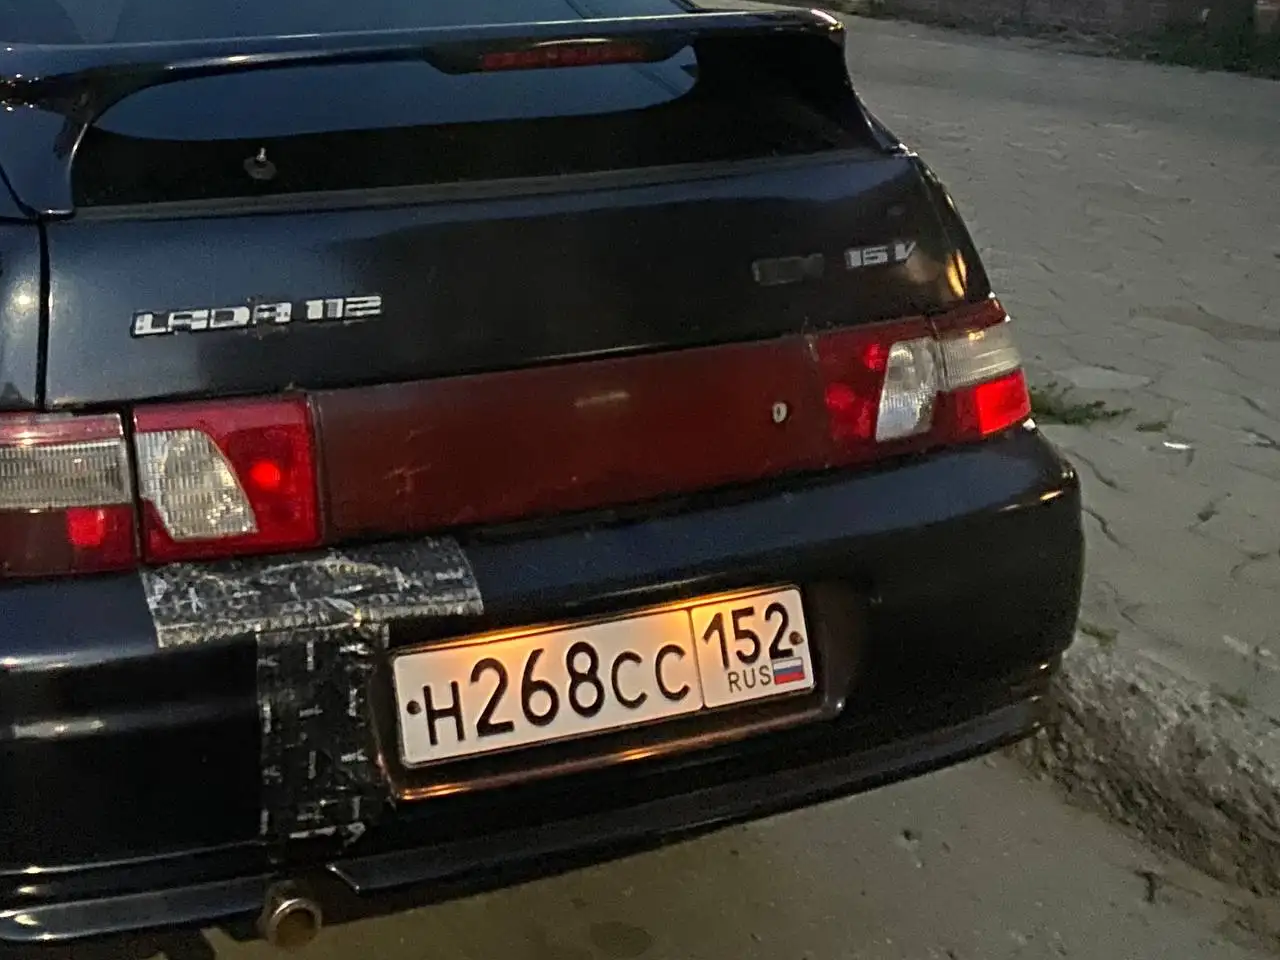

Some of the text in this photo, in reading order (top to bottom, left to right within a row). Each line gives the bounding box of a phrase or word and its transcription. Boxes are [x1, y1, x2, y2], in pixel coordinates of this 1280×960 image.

[133, 295, 382, 337] LADA 112
[702, 601, 796, 671] 152
[726, 669, 772, 694] RUS
